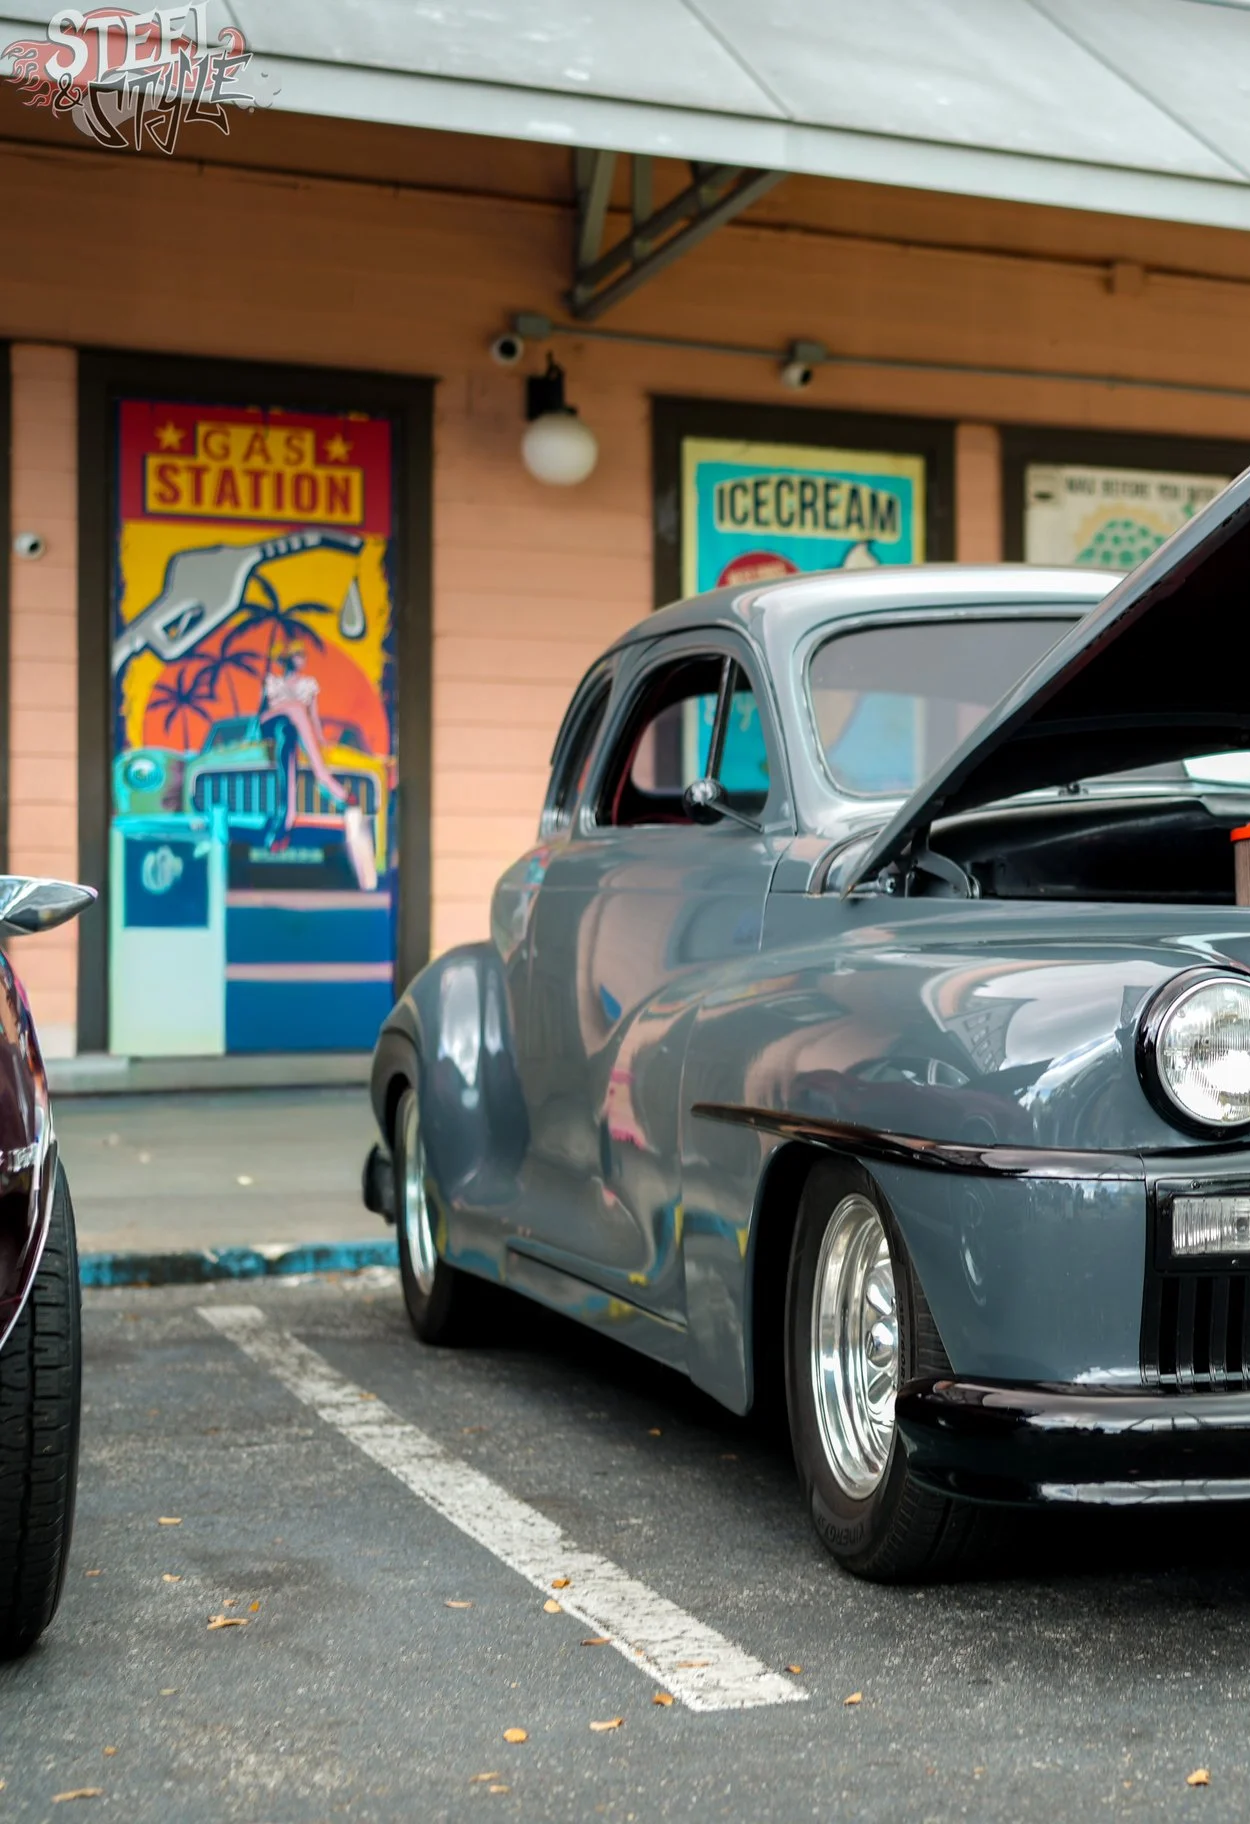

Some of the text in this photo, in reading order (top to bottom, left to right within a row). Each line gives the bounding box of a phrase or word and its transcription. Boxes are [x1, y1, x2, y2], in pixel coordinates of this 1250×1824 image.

[201, 428, 307, 467] GAS
[153, 463, 352, 517] STATION
[717, 478, 898, 535] ICECREAM
